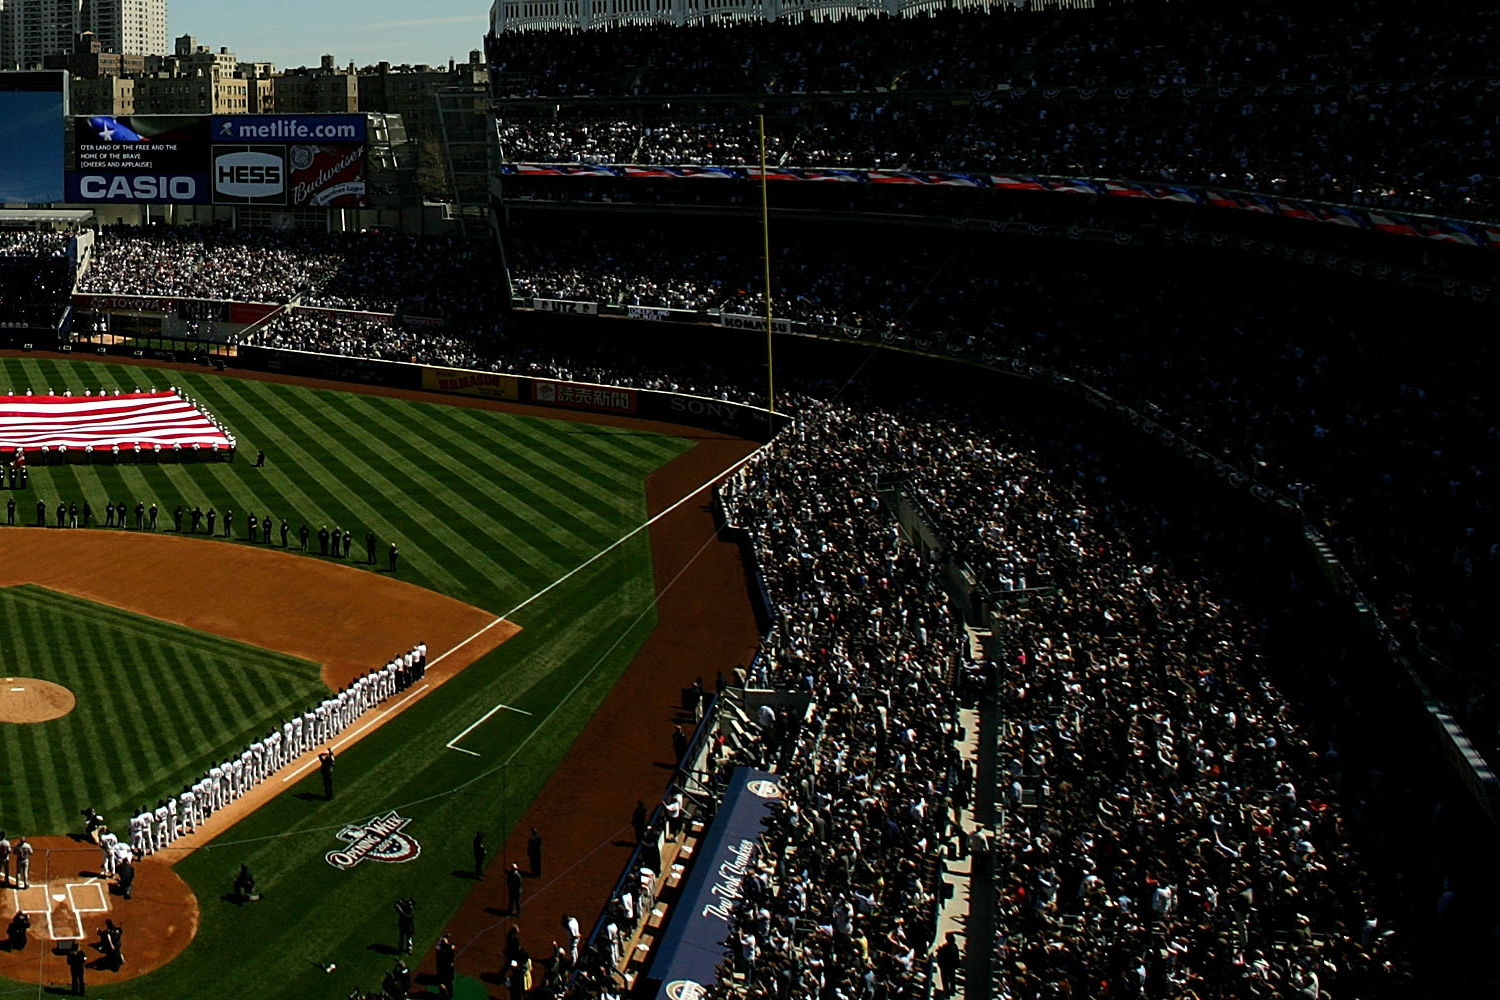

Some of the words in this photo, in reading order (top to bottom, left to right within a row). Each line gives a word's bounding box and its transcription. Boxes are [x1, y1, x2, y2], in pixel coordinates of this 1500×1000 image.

[239, 120, 356, 138] metlife.com
[219, 166, 281, 184] HESS
[292, 145, 364, 206] Budweiser
[80, 175, 196, 199] CASIO
[112, 298, 160, 309] TOYOTA
[552, 301, 577, 312] UTZ
[724, 318, 787, 333] KOMASU
[557, 386, 630, 409] 読売新聞
[670, 398, 739, 420] SONY
[329, 834, 381, 866] OPENING
[364, 815, 405, 838] WEEK
[720, 839, 754, 876] Yankees
[711, 868, 744, 899] York
[702, 898, 733, 921] New
